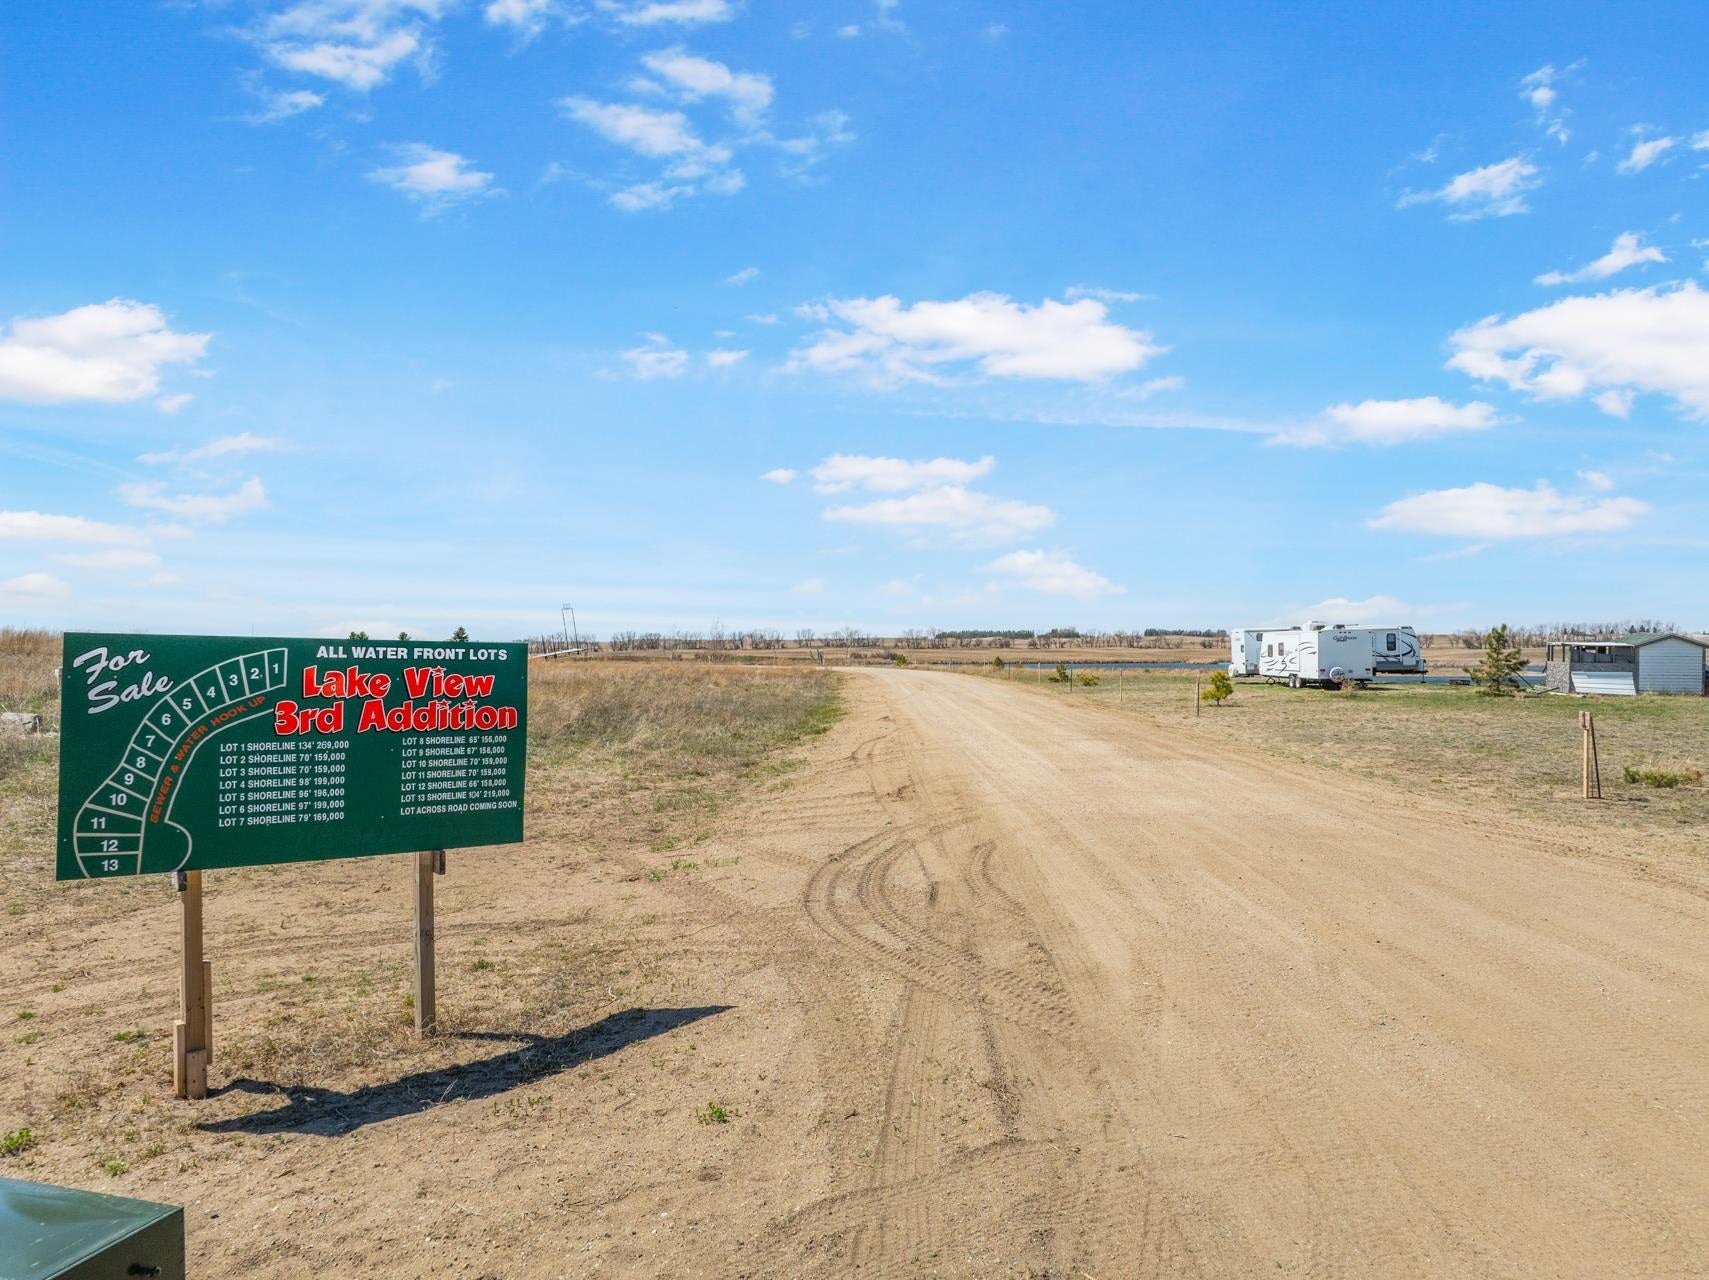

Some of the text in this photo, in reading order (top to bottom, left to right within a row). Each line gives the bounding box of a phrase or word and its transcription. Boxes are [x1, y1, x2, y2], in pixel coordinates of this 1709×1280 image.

[316, 645, 508, 661] ALL WATER FRONT LOTS
[72, 646, 151, 685] For
[272, 663, 279, 674] 1
[229, 674, 239, 686] 3
[250, 668, 260, 680] 2
[302, 664, 496, 699] Lake View
[87, 670, 174, 715] Sale
[206, 686, 216, 698] 4
[182, 698, 192, 710] 5
[161, 713, 171, 726] 6
[274, 698, 518, 735] 3rd Addition
[145, 735, 156, 748] 7
[220, 743, 238, 752] LOT
[247, 741, 296, 751] SHORELINE
[298, 741, 314, 750] 134'
[316, 740, 350, 750] 269,000
[402, 737, 417, 746] LOT
[419, 737, 424, 745] 8
[425, 736, 465, 745] SHORELINE
[469, 736, 480, 744] 65'
[402, 749, 417, 757] LOT
[419, 749, 423, 757] 9
[425, 747, 465, 756] SHORELINE
[466, 747, 478, 755] 67'
[136, 756, 146, 769] 8
[150, 775, 173, 823] SEWER
[175, 724, 209, 761] WATER
[210, 704, 248, 727] HOOK
[248, 696, 266, 708] UP
[220, 755, 238, 765] LOT
[240, 756, 246, 764] 2
[248, 753, 297, 764] SHORELINE
[299, 754, 312, 762] 70'
[402, 760, 416, 769] LOT
[418, 760, 426, 768] 10
[428, 758, 468, 768] SHORELINE
[470, 758, 480, 766] 70'
[219, 768, 238, 777] LOT
[240, 768, 246, 776] 3
[248, 766, 297, 776] SHORELINE
[299, 766, 312, 774] 70'
[401, 771, 416, 780] LOT
[426, 769, 467, 779] SHORELINE
[124, 773, 135, 785] 9
[219, 780, 237, 790] LOT
[248, 778, 297, 788] SHORELINE
[299, 778, 312, 786] 98'
[401, 783, 416, 791] LOT
[418, 783, 426, 791] 12
[427, 780, 467, 790] SHORELINE
[109, 793, 127, 806] 10
[219, 793, 237, 802] LOT
[239, 793, 245, 801] 5
[247, 790, 296, 801] SHORELINE
[298, 790, 312, 798] 96'
[401, 794, 416, 803] LOT
[427, 791, 467, 801] SHORELINE
[468, 791, 482, 799] 104'
[483, 789, 510, 798] 219,000
[219, 805, 237, 815] LOT
[247, 802, 296, 813] SHORELINE
[298, 802, 311, 810] 97'
[400, 800, 518, 816] LOT ACROSS ROAD COMING SOON
[90, 817, 106, 829] 11
[218, 818, 237, 827] LOT
[247, 815, 296, 825] SHORELINE
[298, 814, 311, 822] 79'
[313, 812, 344, 823] 169,000
[100, 839, 119, 852] 12
[101, 859, 119, 871] 13
